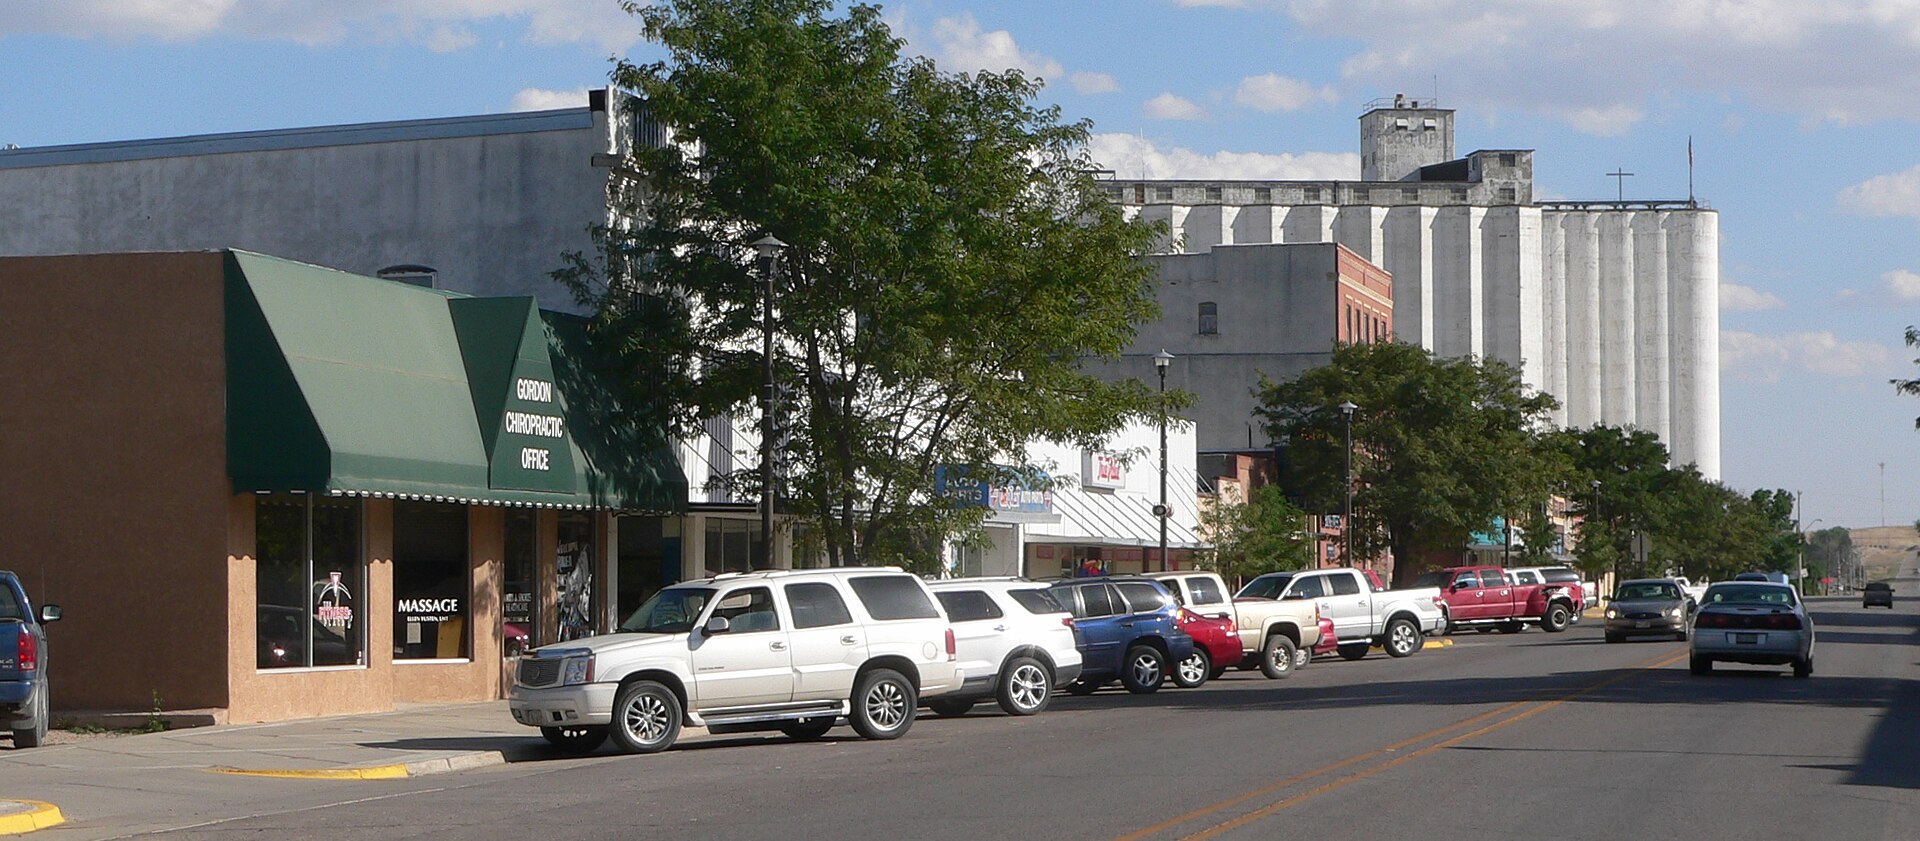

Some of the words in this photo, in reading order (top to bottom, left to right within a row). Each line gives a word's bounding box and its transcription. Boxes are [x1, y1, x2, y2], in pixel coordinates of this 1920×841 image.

[517, 378, 552, 403] GORDON
[505, 411, 563, 438] CHIROPRACTIC
[521, 447, 550, 471] OFFICE
[398, 598, 458, 613] MASSAGE
